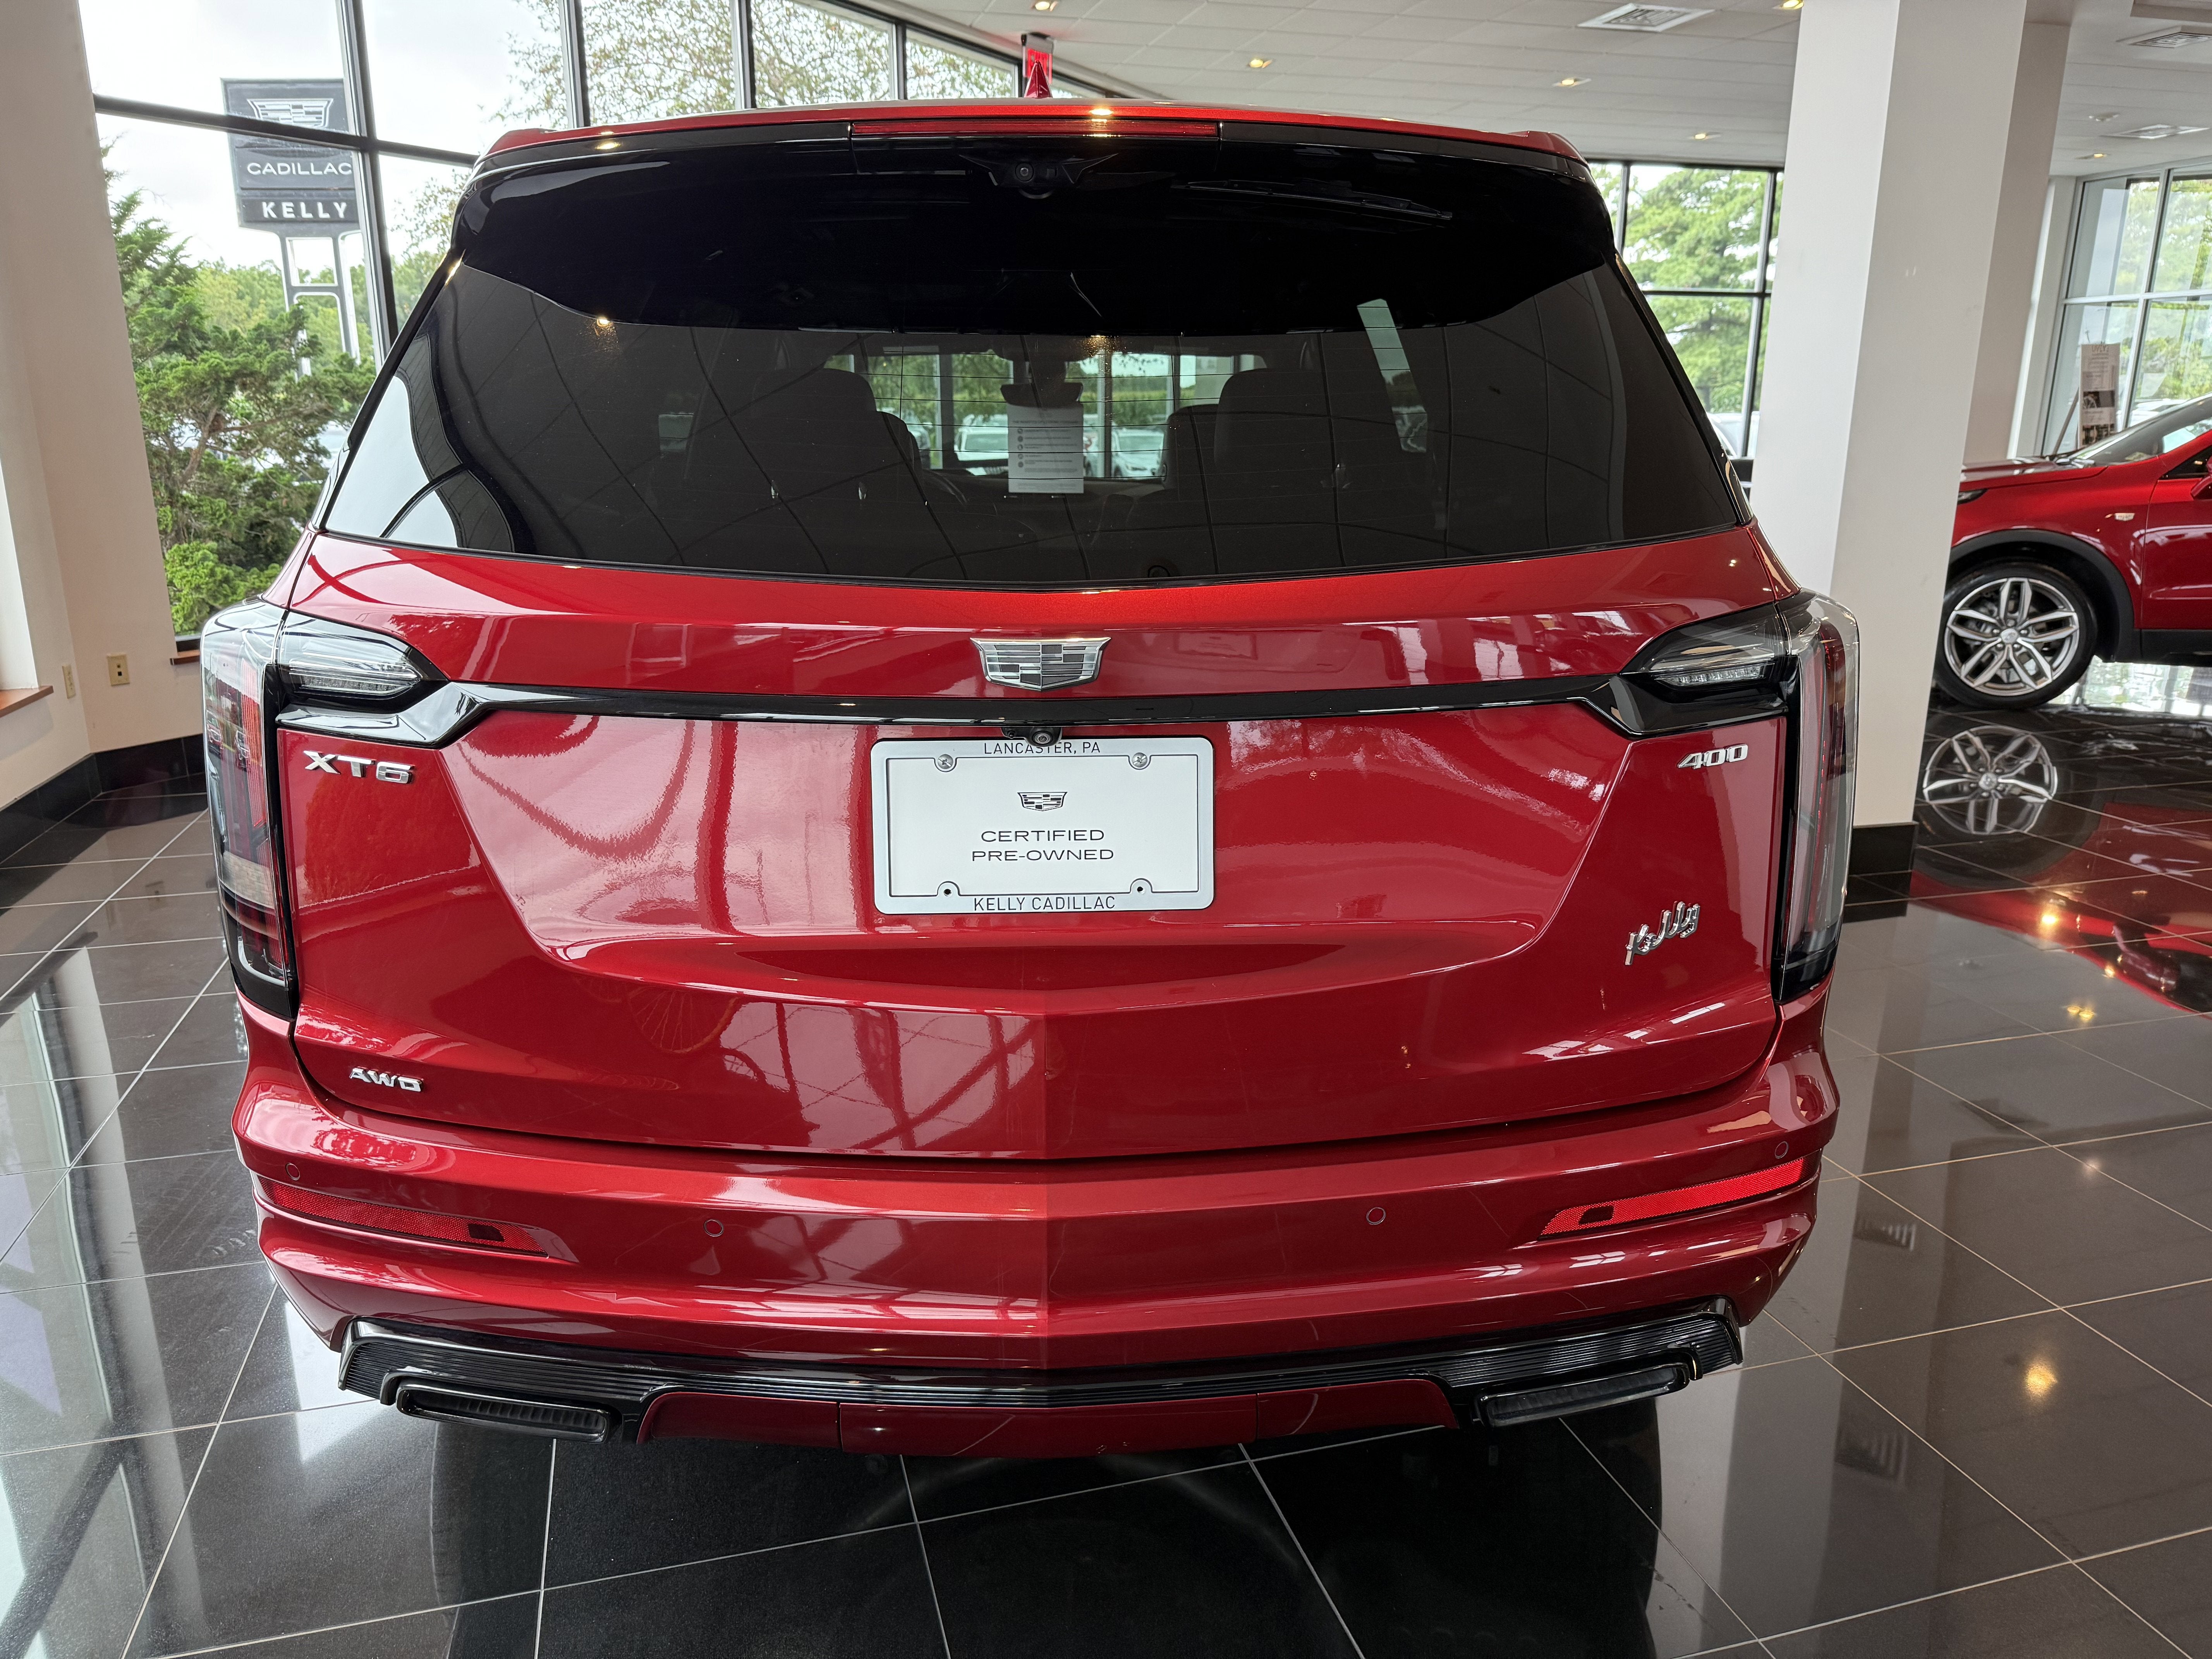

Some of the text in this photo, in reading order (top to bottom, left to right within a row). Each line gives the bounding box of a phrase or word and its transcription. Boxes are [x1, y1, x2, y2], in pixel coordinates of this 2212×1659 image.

[247, 162, 352, 175] CADILLAC
[262, 201, 347, 218] KELLY
[1083, 742, 1101, 753] PA
[1677, 744, 1748, 769] 400
[303, 750, 414, 784] XT6
[981, 830, 1104, 842] CERTIFIED
[972, 849, 1114, 862] PRE-OWNED
[974, 896, 1115, 911] KELLY CADILLAC
[1625, 901, 1700, 965] Kelly
[349, 1066, 424, 1092] AWD
